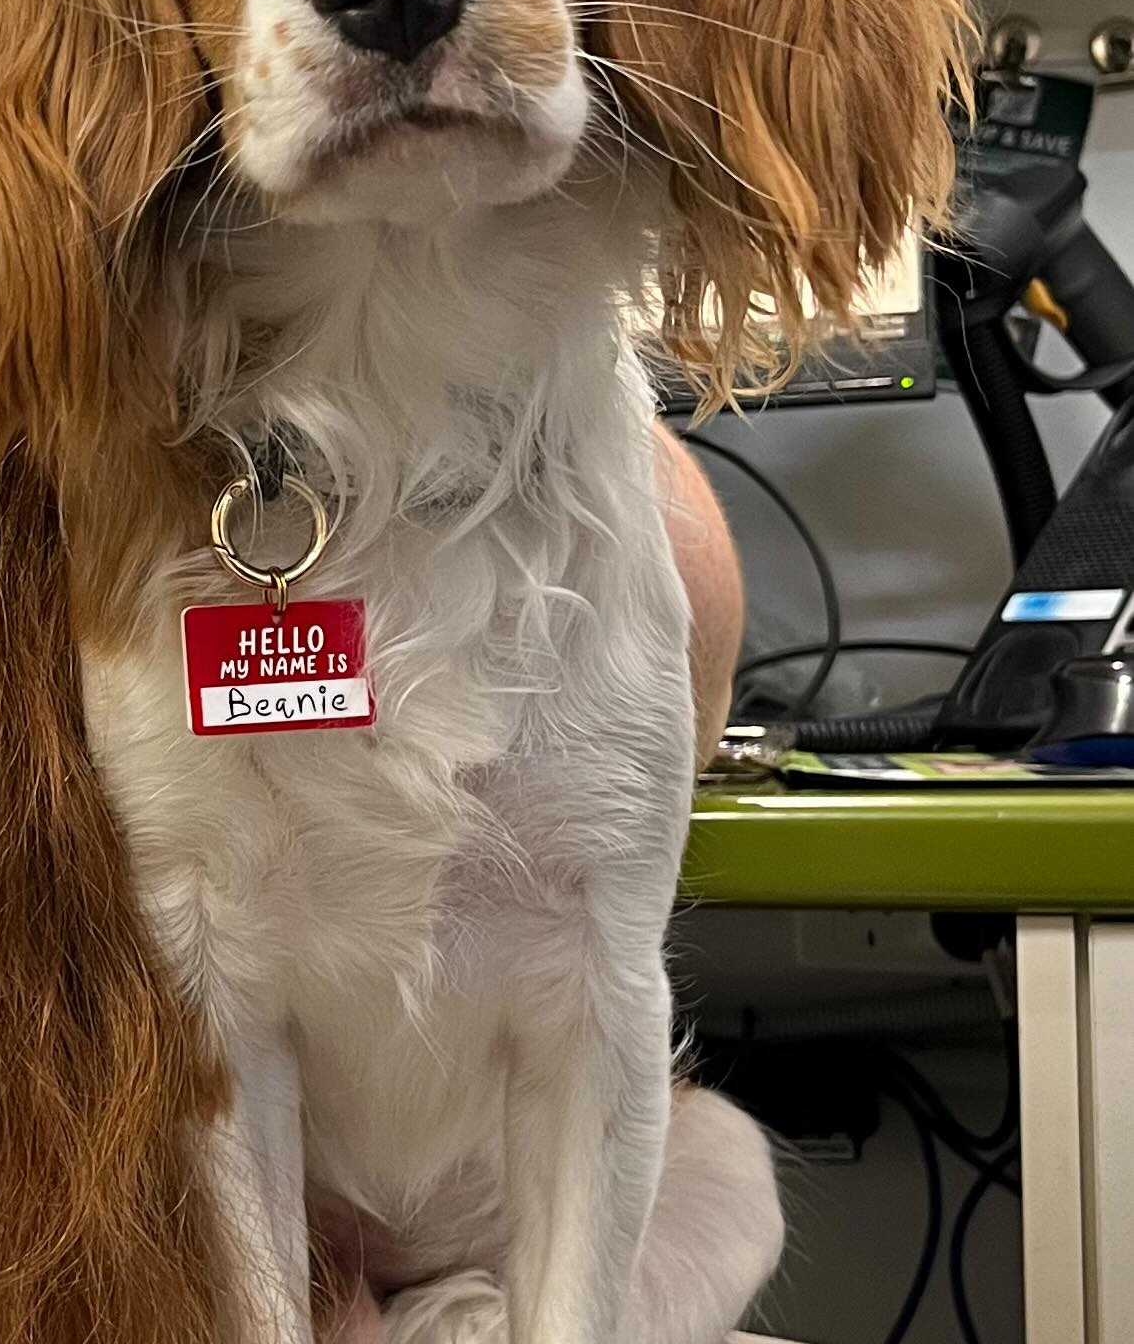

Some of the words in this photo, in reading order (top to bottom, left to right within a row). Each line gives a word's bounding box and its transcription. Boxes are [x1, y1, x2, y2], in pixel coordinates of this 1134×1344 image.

[238, 625, 324, 656] HELLO
[220, 659, 250, 680] MY
[260, 654, 317, 677] NAME
[327, 653, 348, 674] IS
[225, 685, 349, 723] Beanie
